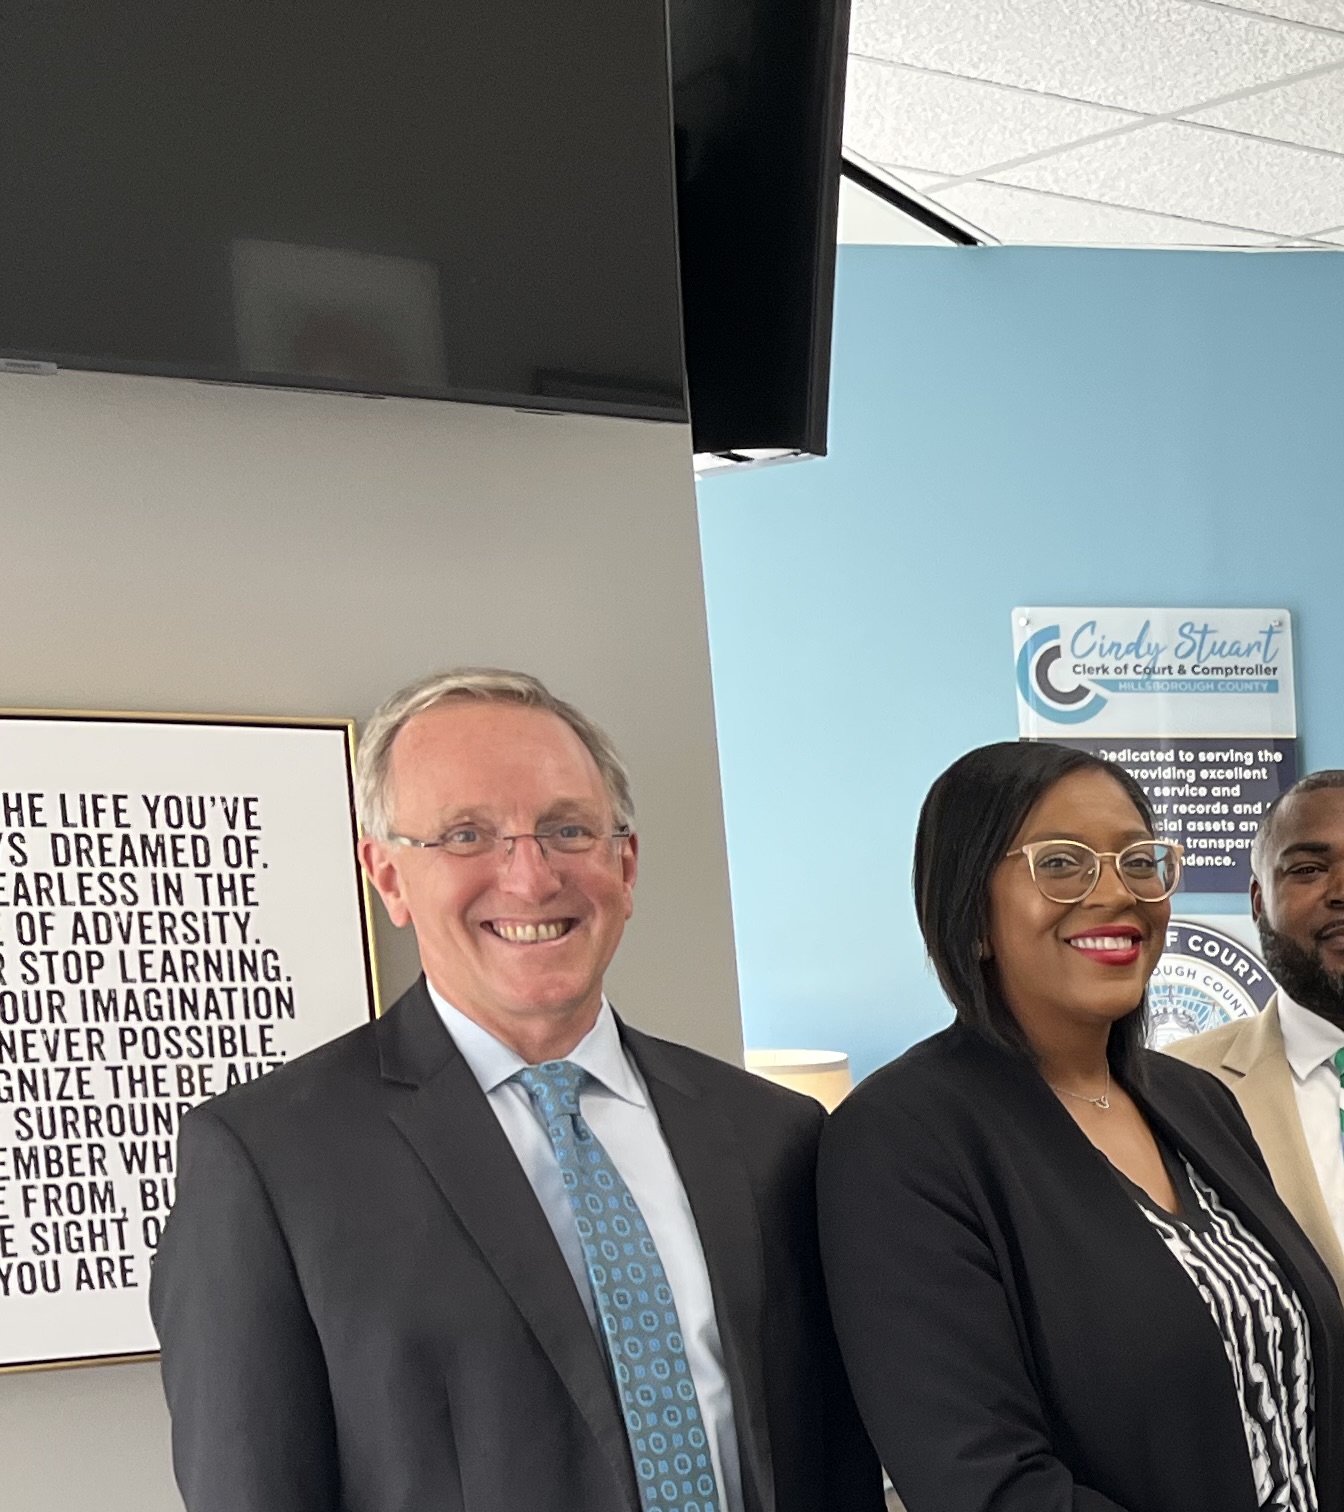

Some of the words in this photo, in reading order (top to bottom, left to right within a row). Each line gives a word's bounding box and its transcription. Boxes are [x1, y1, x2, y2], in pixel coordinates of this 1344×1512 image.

[1070, 620, 1168, 681] Cindy
[1174, 621, 1283, 664] Stuart
[1072, 664, 1110, 676] Clerk
[1114, 664, 1128, 676] of
[1132, 664, 1174, 676] Court
[1178, 664, 1187, 676] &
[1191, 664, 1279, 678] Comptroller
[1118, 681, 1215, 692] HILLSBOROUGH
[1217, 681, 1269, 692] COUNTY
[1178, 749, 1194, 762] to
[1198, 749, 1253, 765] serving
[1257, 749, 1283, 762] the
[1199, 767, 1269, 780] excellent
[1153, 784, 1208, 797] service
[1211, 784, 1241, 797] and
[1153, 803, 1169, 815] ur
[1172, 802, 1229, 815] records
[1232, 801, 1262, 815] and
[2, 792, 48, 828] HE
[59, 793, 131, 829] LIFE
[141, 794, 262, 831] YOU'VE
[1186, 819, 1235, 832] assets
[50, 833, 211, 868] DREAMED
[223, 834, 268, 869] OF.
[1181, 853, 1237, 867] ndence.
[151, 872, 184, 907] IN
[194, 872, 260, 907] THE
[15, 911, 56, 946] OF
[71, 910, 262, 946] ADVERSITY.
[20, 950, 106, 985] STOP
[118, 948, 292, 984] LEARNING.
[1188, 934, 1263, 987] COURT
[79, 986, 296, 1023] IMAGINATION
[1202, 975, 1249, 1018] COUNT
[0, 1027, 107, 1064] NEVER
[118, 1023, 287, 1060] POSSIBLE.
[104, 1063, 171, 1099] THE
[14, 1102, 194, 1141] SURROUN
[21, 1180, 128, 1219] FROM,
[30, 1218, 129, 1255] SIGHT
[0, 1260, 62, 1297] YOU
[75, 1255, 139, 1292] ARE
